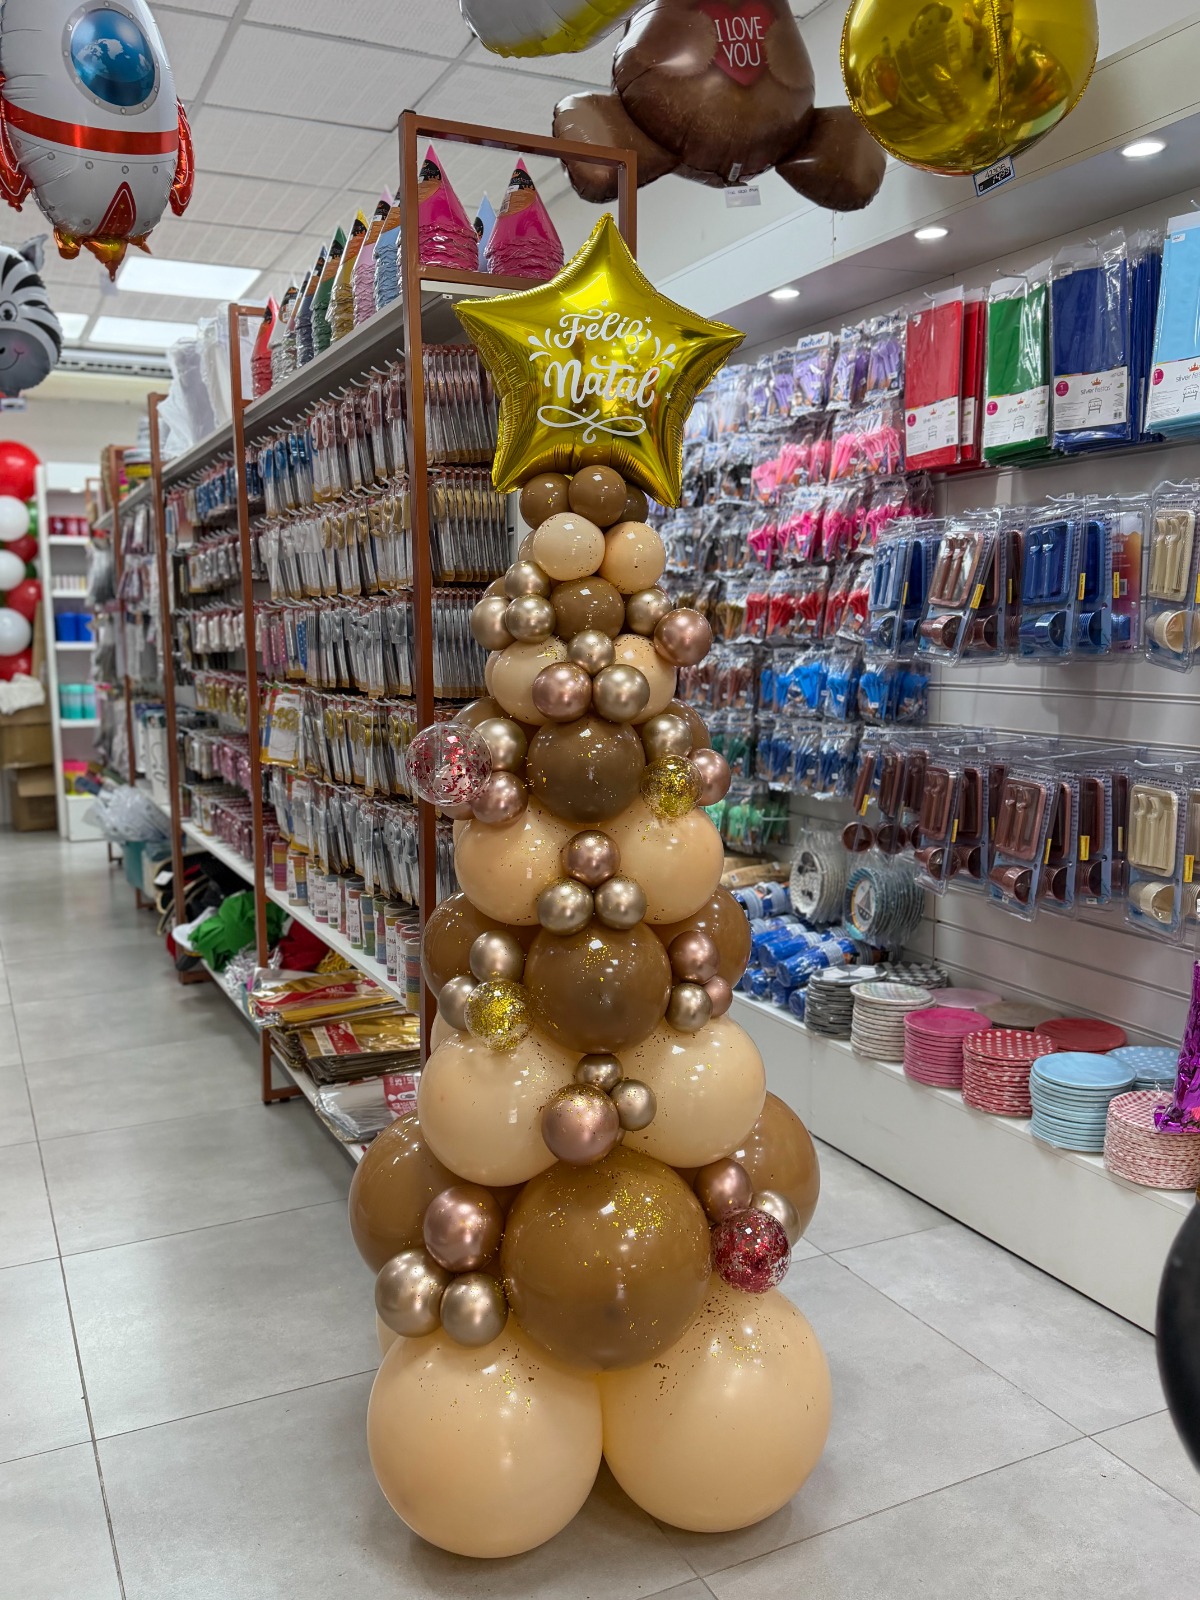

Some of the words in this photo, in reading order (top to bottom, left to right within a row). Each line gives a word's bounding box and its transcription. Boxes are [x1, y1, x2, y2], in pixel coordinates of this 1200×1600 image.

[714, 19, 723, 42] I
[725, 16, 765, 41] LOVE
[722, 42, 761, 68] YOU
[553, 308, 652, 355] Feliz
[543, 355, 661, 408] Natal
